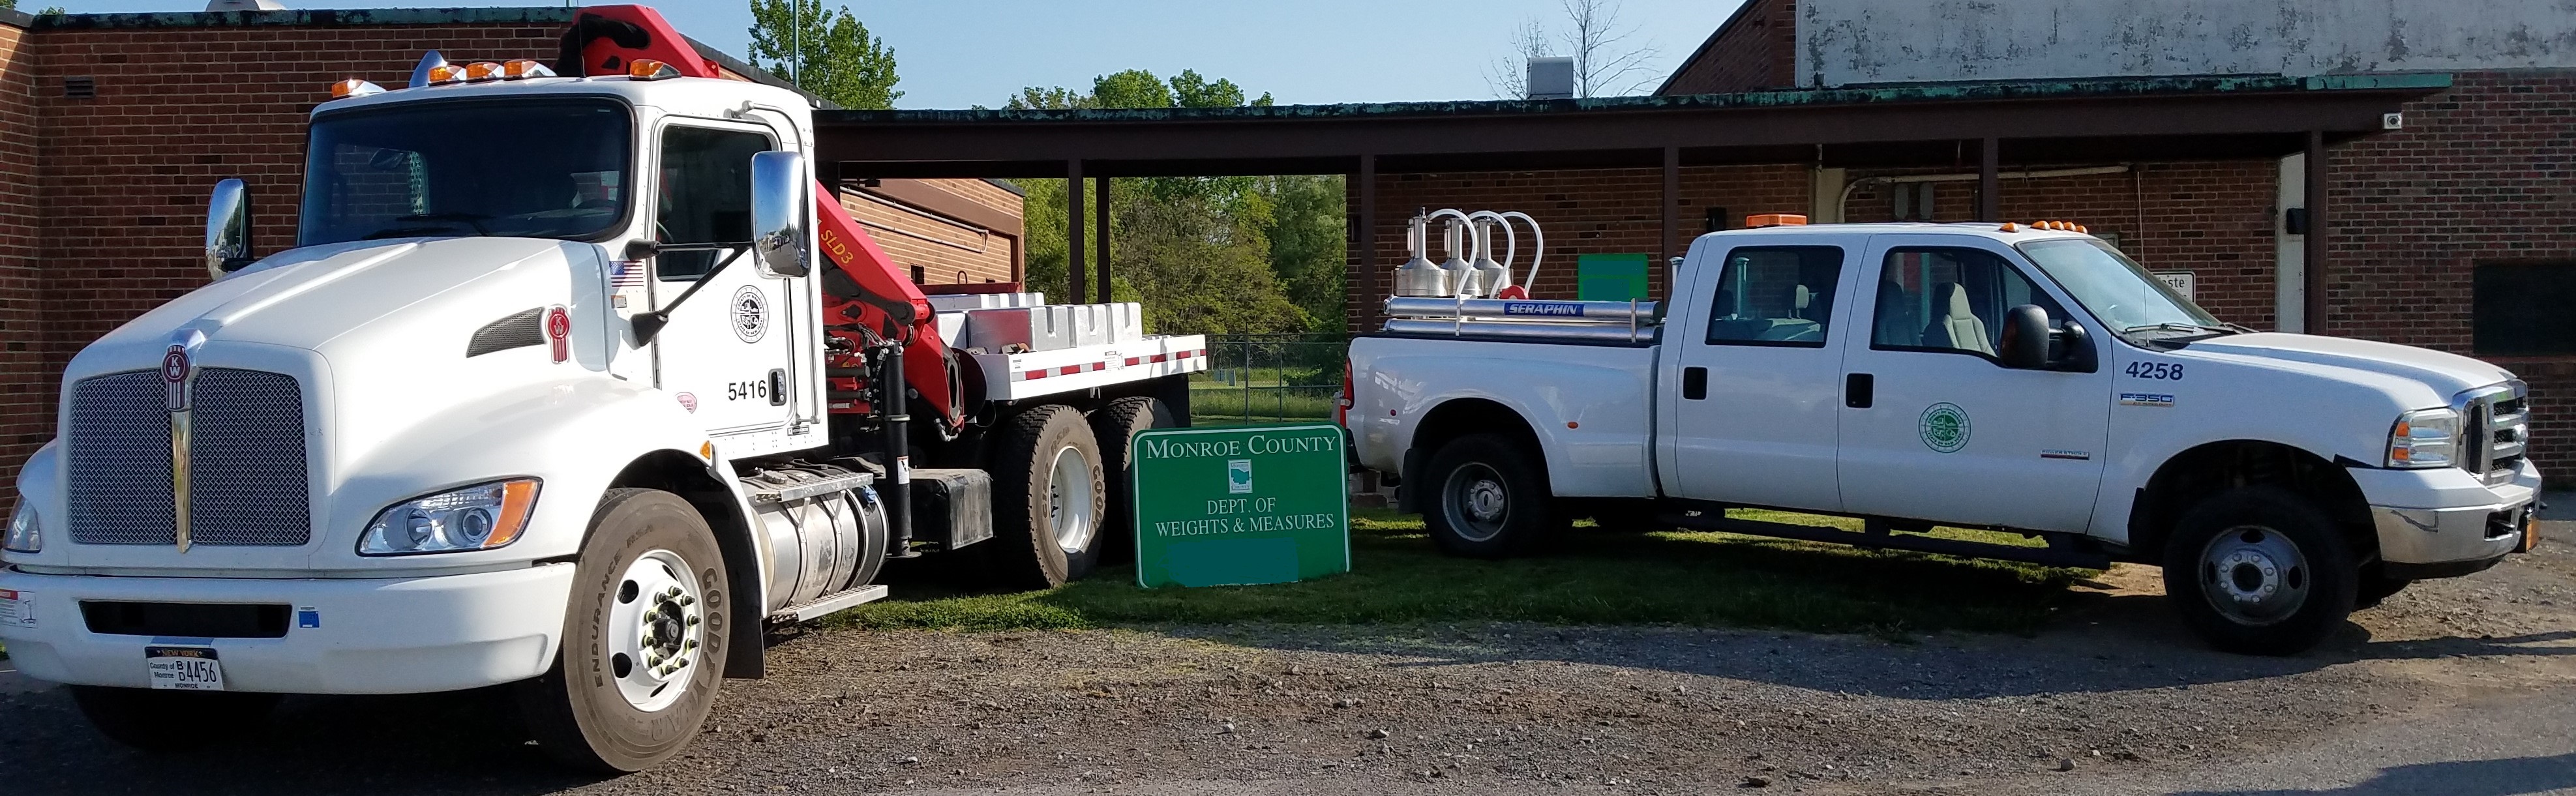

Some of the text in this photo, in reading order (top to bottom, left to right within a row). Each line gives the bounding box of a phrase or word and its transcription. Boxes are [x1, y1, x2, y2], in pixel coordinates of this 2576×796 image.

[820, 229, 854, 264] SLD3
[1508, 303, 1578, 315] SERAPHIN
[2125, 361, 2183, 381] 4258
[728, 380, 767, 401] 5416
[1145, 435, 1337, 459] MONROE COUNTY
[1206, 497, 1276, 515] DEPT. OF
[1155, 513, 1335, 537] WEIGHTS & MEASURES
[592, 548, 623, 688] ENDURANCE
[180, 649, 200, 658] YORK
